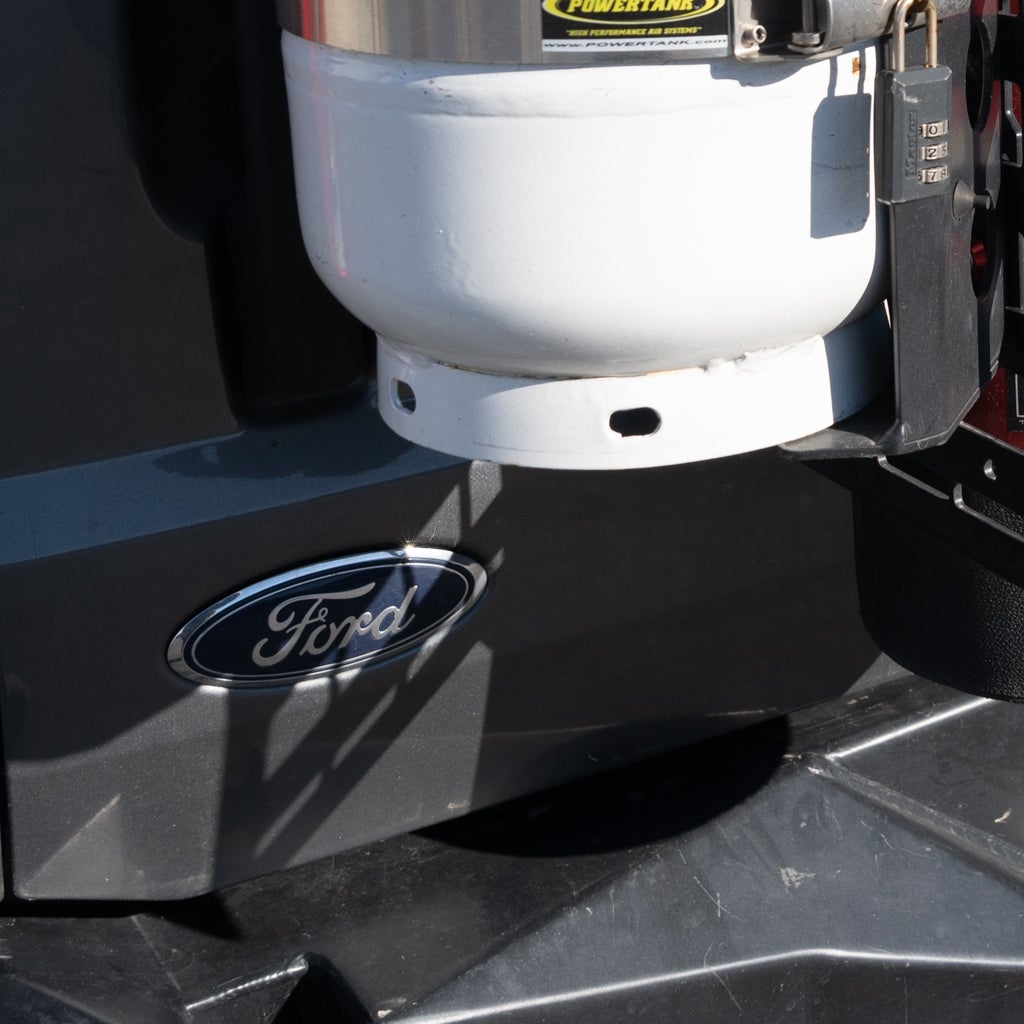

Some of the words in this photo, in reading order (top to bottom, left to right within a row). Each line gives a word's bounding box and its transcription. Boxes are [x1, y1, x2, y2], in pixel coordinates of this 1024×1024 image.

[589, 28, 646, 36] PERFORMANCE
[543, 39, 727, 48] www.POWERTANK.com
[251, 581, 418, 667] Ford
